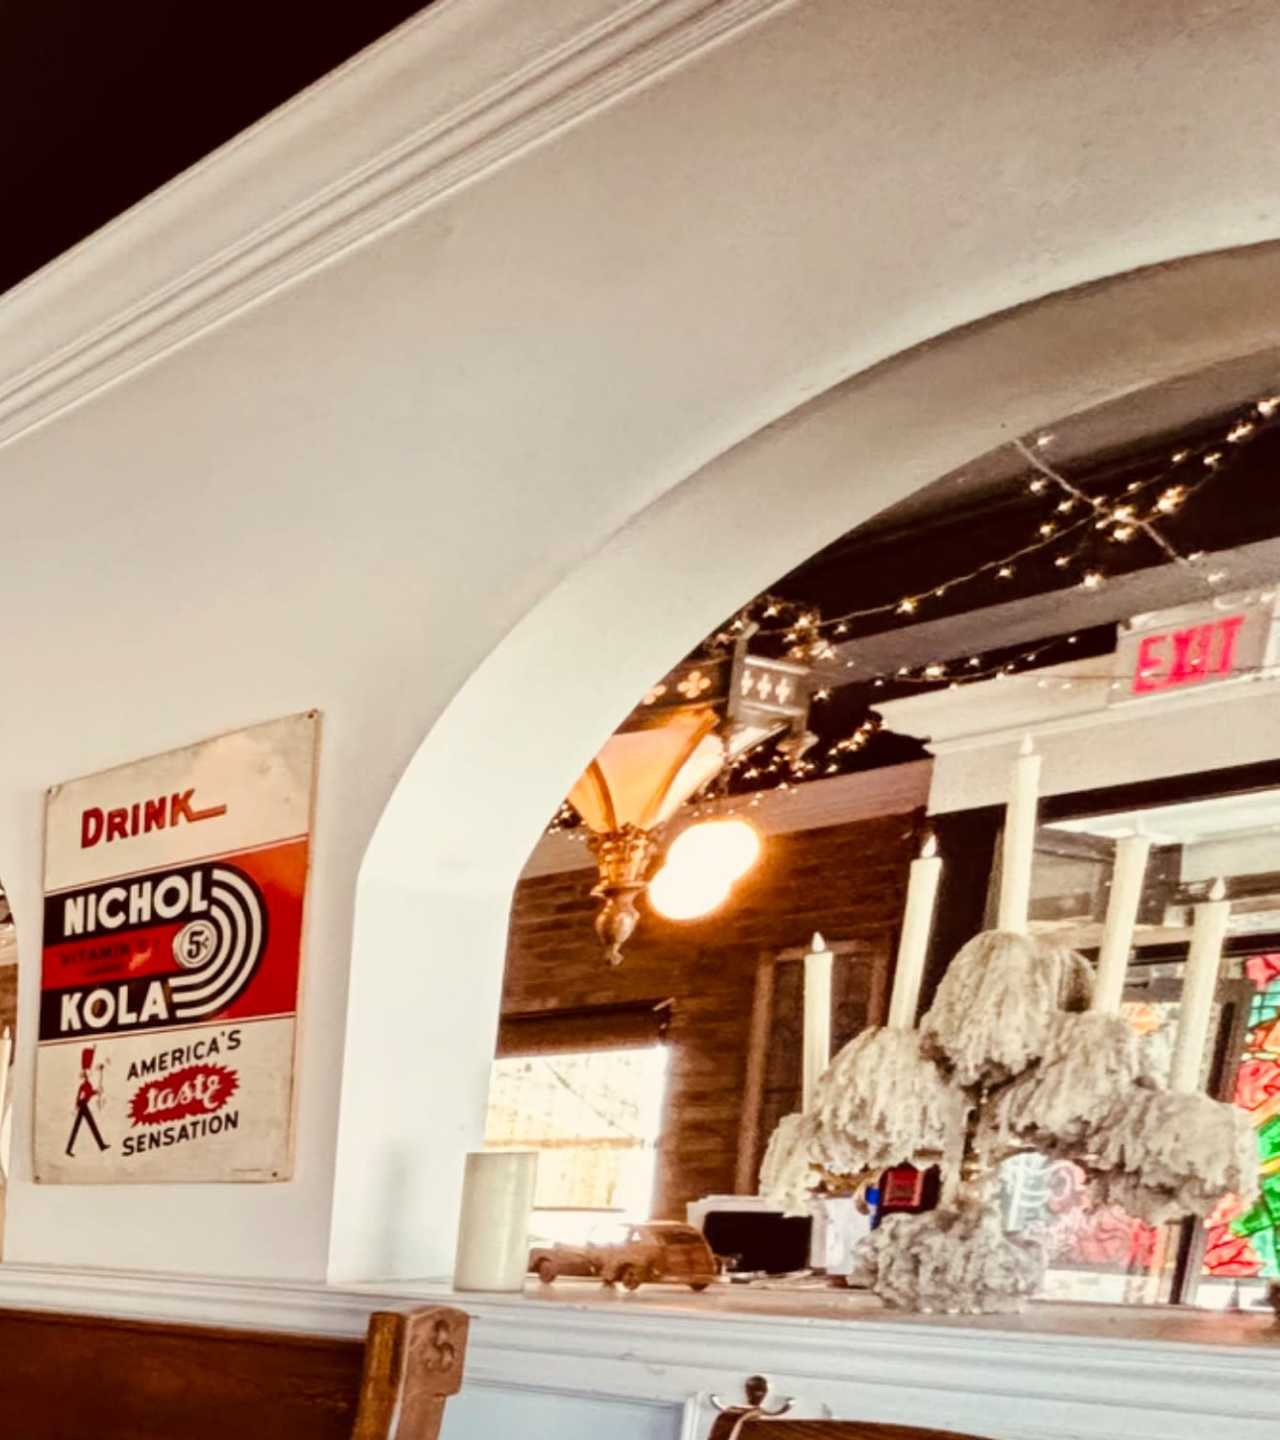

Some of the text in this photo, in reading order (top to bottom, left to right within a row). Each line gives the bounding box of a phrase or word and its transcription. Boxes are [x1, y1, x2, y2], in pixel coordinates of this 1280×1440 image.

[1132, 615, 1245, 694] EXIT
[80, 788, 227, 848] DRINK
[64, 871, 209, 936] NICHOL
[59, 980, 169, 1032] KOLA
[127, 1029, 242, 1081] AMERICA'S
[143, 1073, 222, 1115] taste
[121, 1110, 239, 1157] SENSATION
